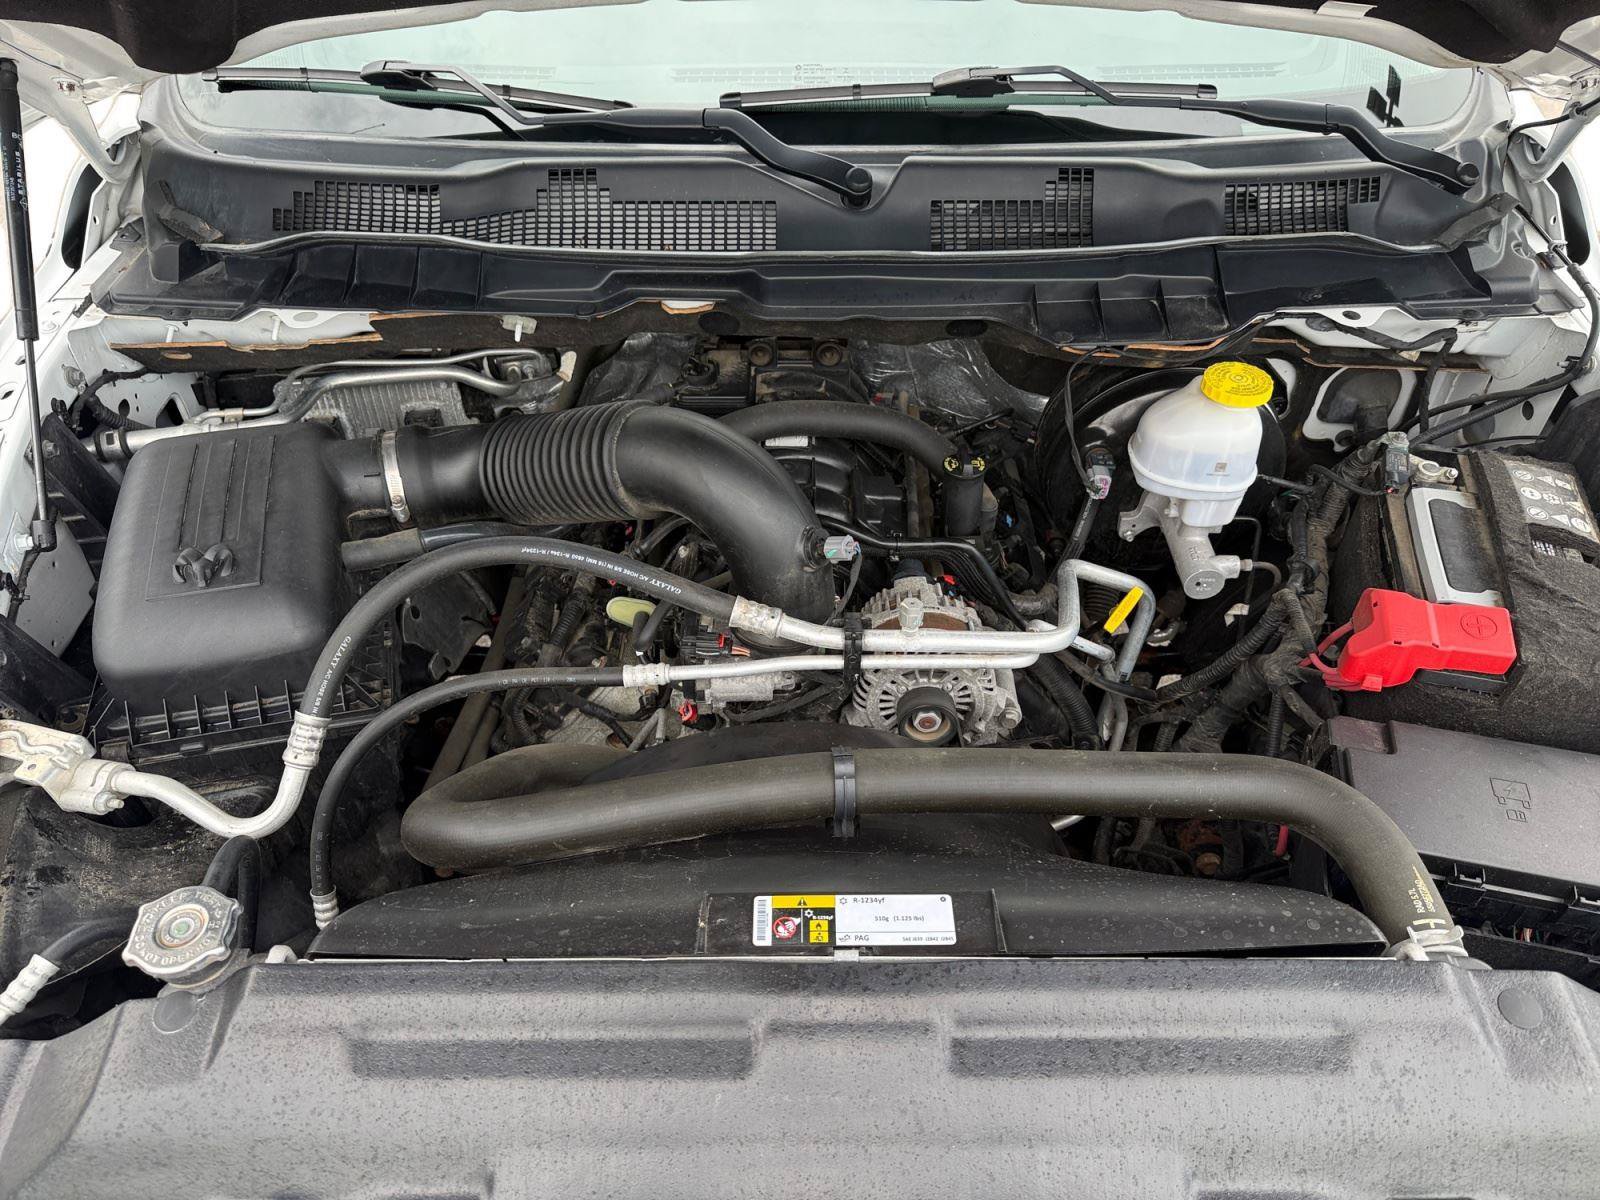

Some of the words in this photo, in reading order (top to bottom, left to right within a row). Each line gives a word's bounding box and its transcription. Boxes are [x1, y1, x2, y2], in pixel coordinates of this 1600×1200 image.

[622, 567, 638, 578] HOSE
[638, 573, 648, 582] A/C
[648, 578, 682, 594] GALAXY
[330, 635, 352, 669] GALAXY
[318, 679, 328, 697] HOSE
[853, 897, 885, 905] R-1234yf
